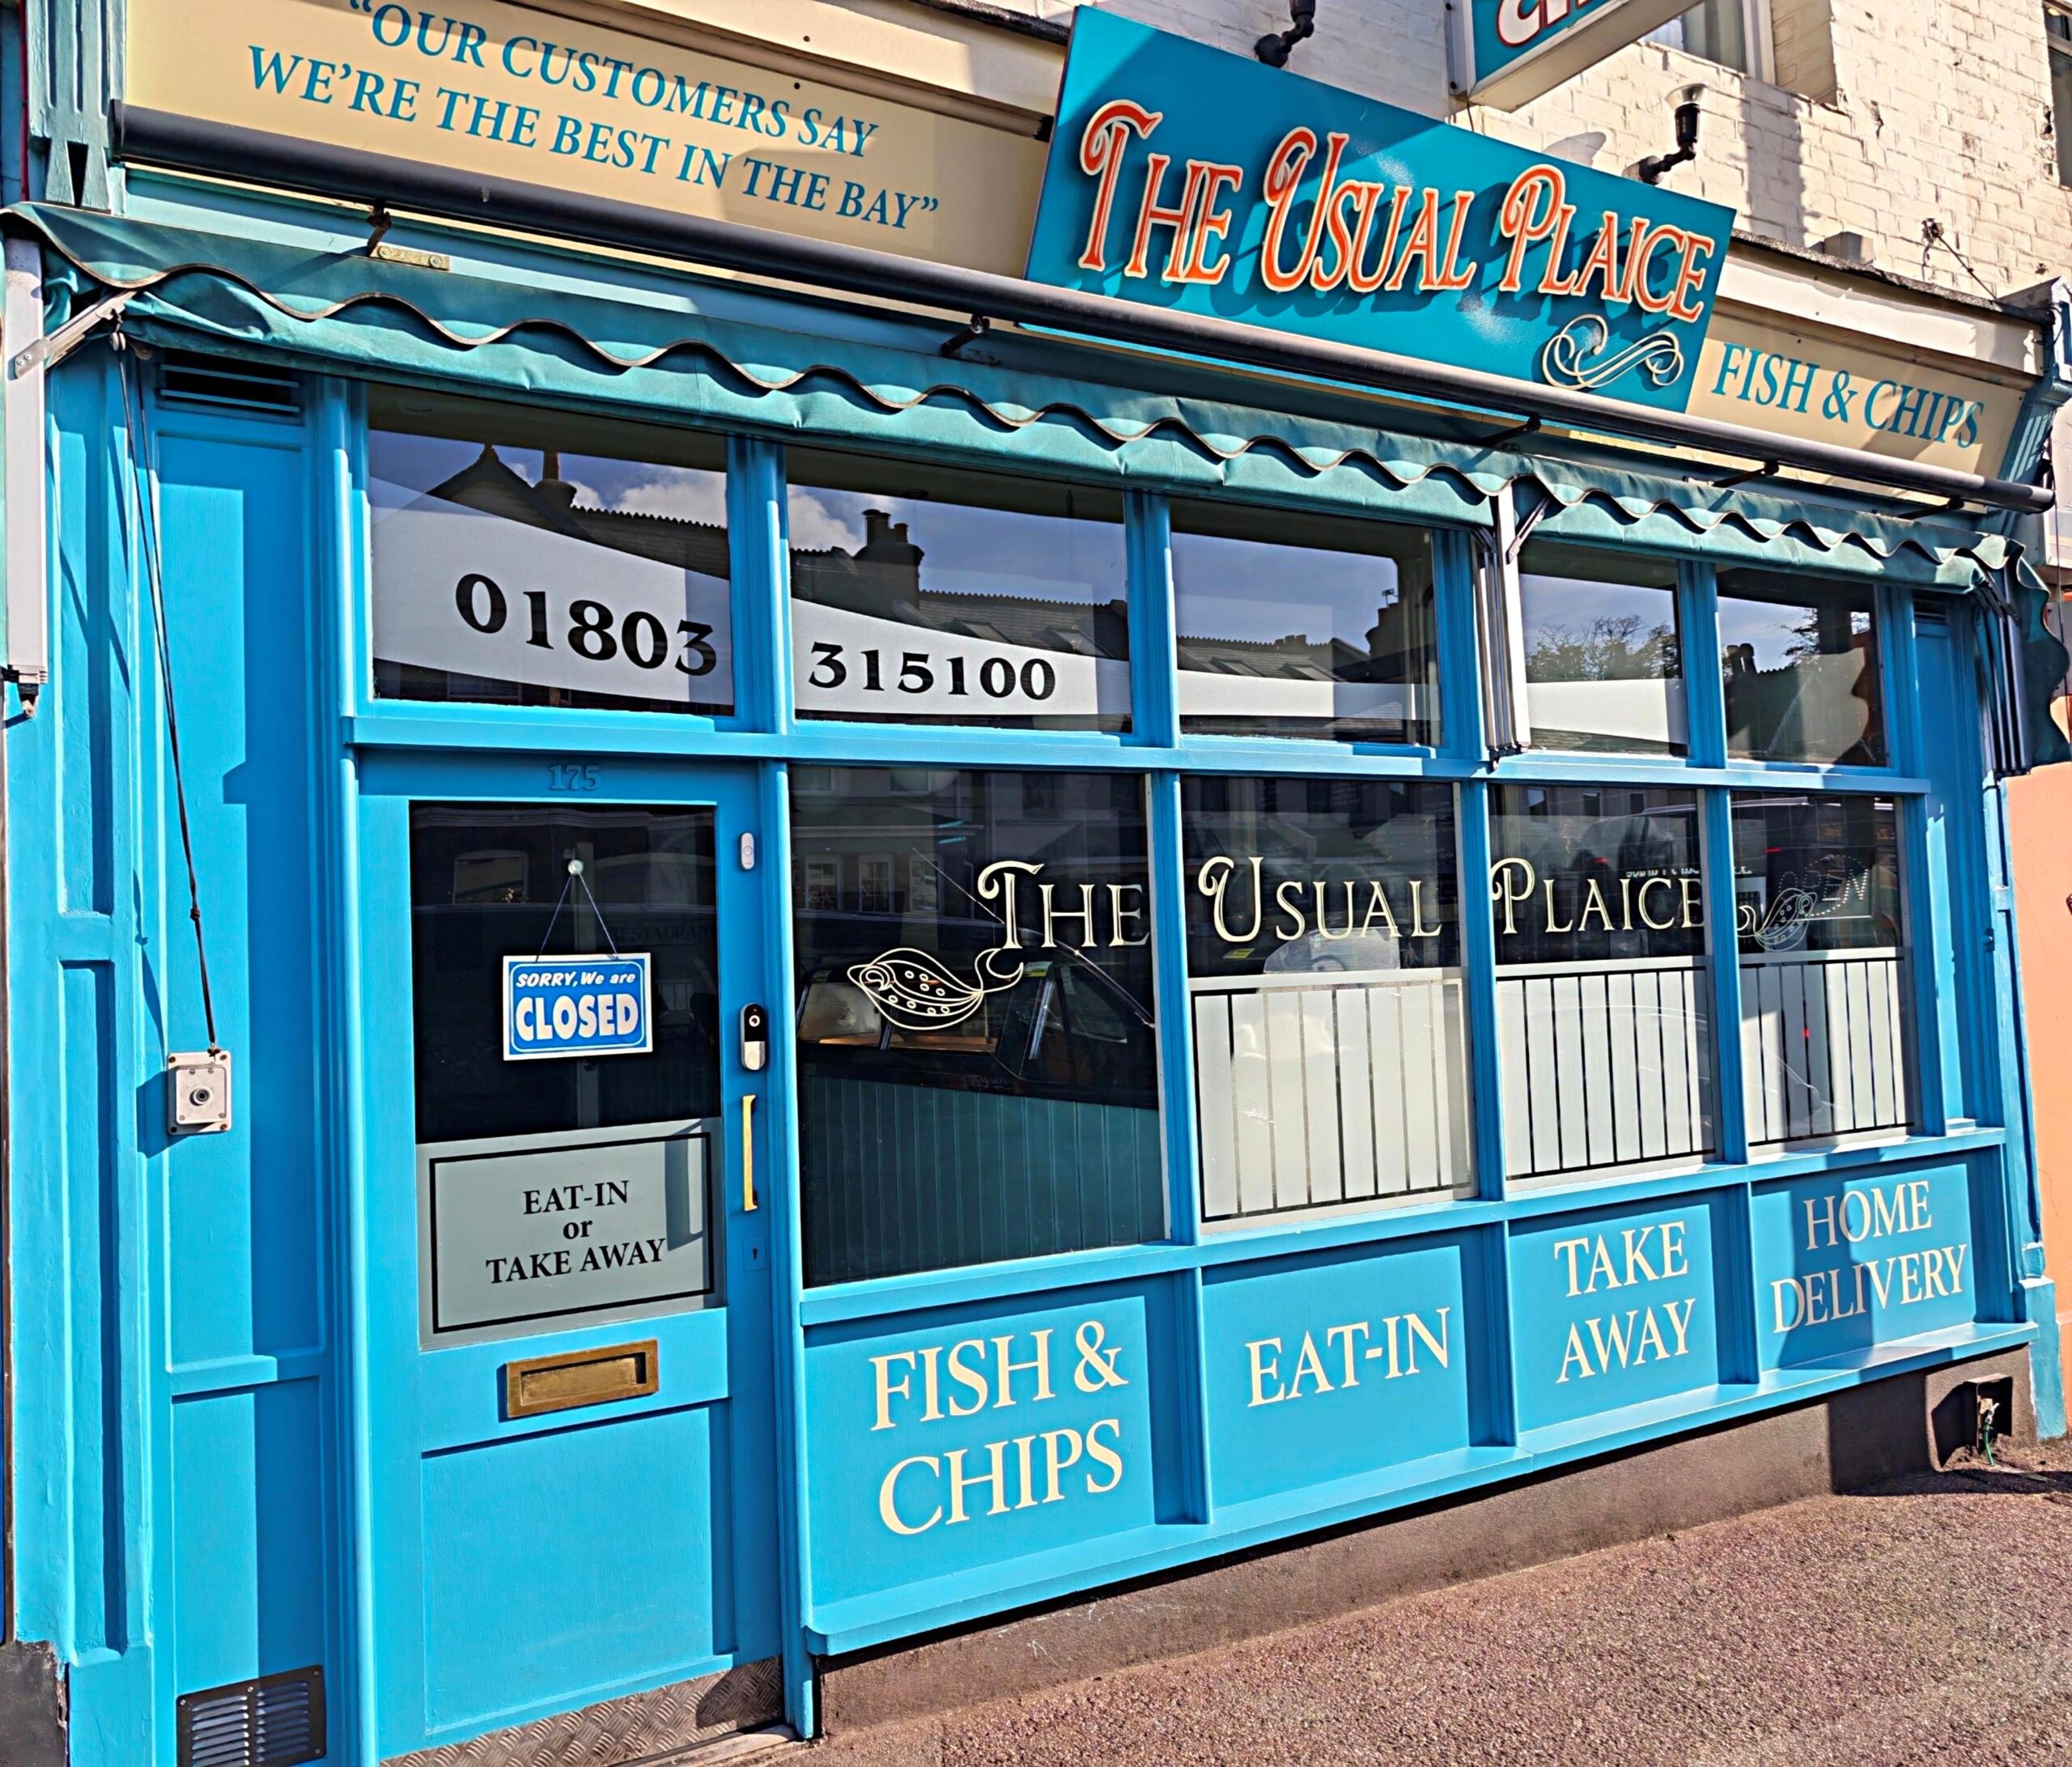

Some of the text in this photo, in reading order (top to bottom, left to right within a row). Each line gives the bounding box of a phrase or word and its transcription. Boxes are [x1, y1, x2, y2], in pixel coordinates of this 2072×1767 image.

[350, 0, 878, 158] “OUR CUSTOMERS SAY
[248, 45, 939, 230] WE’RE THE BEST IN THE BAY”
[1078, 99, 1715, 323] THE USUAL PLAICE
[1713, 342, 1983, 449] FISH & CHIPS
[455, 572, 1056, 702] 01803 315100
[548, 763, 602, 792] 175
[977, 860, 1150, 949] THE
[1198, 856, 1442, 943] USUAL
[516, 971, 636, 988] SORRY, We are
[516, 992, 639, 1043] CLOSED
[522, 1179, 630, 1215] EAT-IN
[563, 1219, 593, 1240] or
[1803, 1180, 1933, 1251] HOME
[485, 1238, 667, 1284] TAKE AWAY
[1554, 1221, 1688, 1298] TAKE
[1770, 1243, 1968, 1334] DELIVERY
[868, 1320, 1129, 1432] FISH &
[1245, 1306, 1451, 1408] EAT-IN
[1556, 1298, 1696, 1384] AWAY
[878, 1418, 1123, 1536] CHIPS
